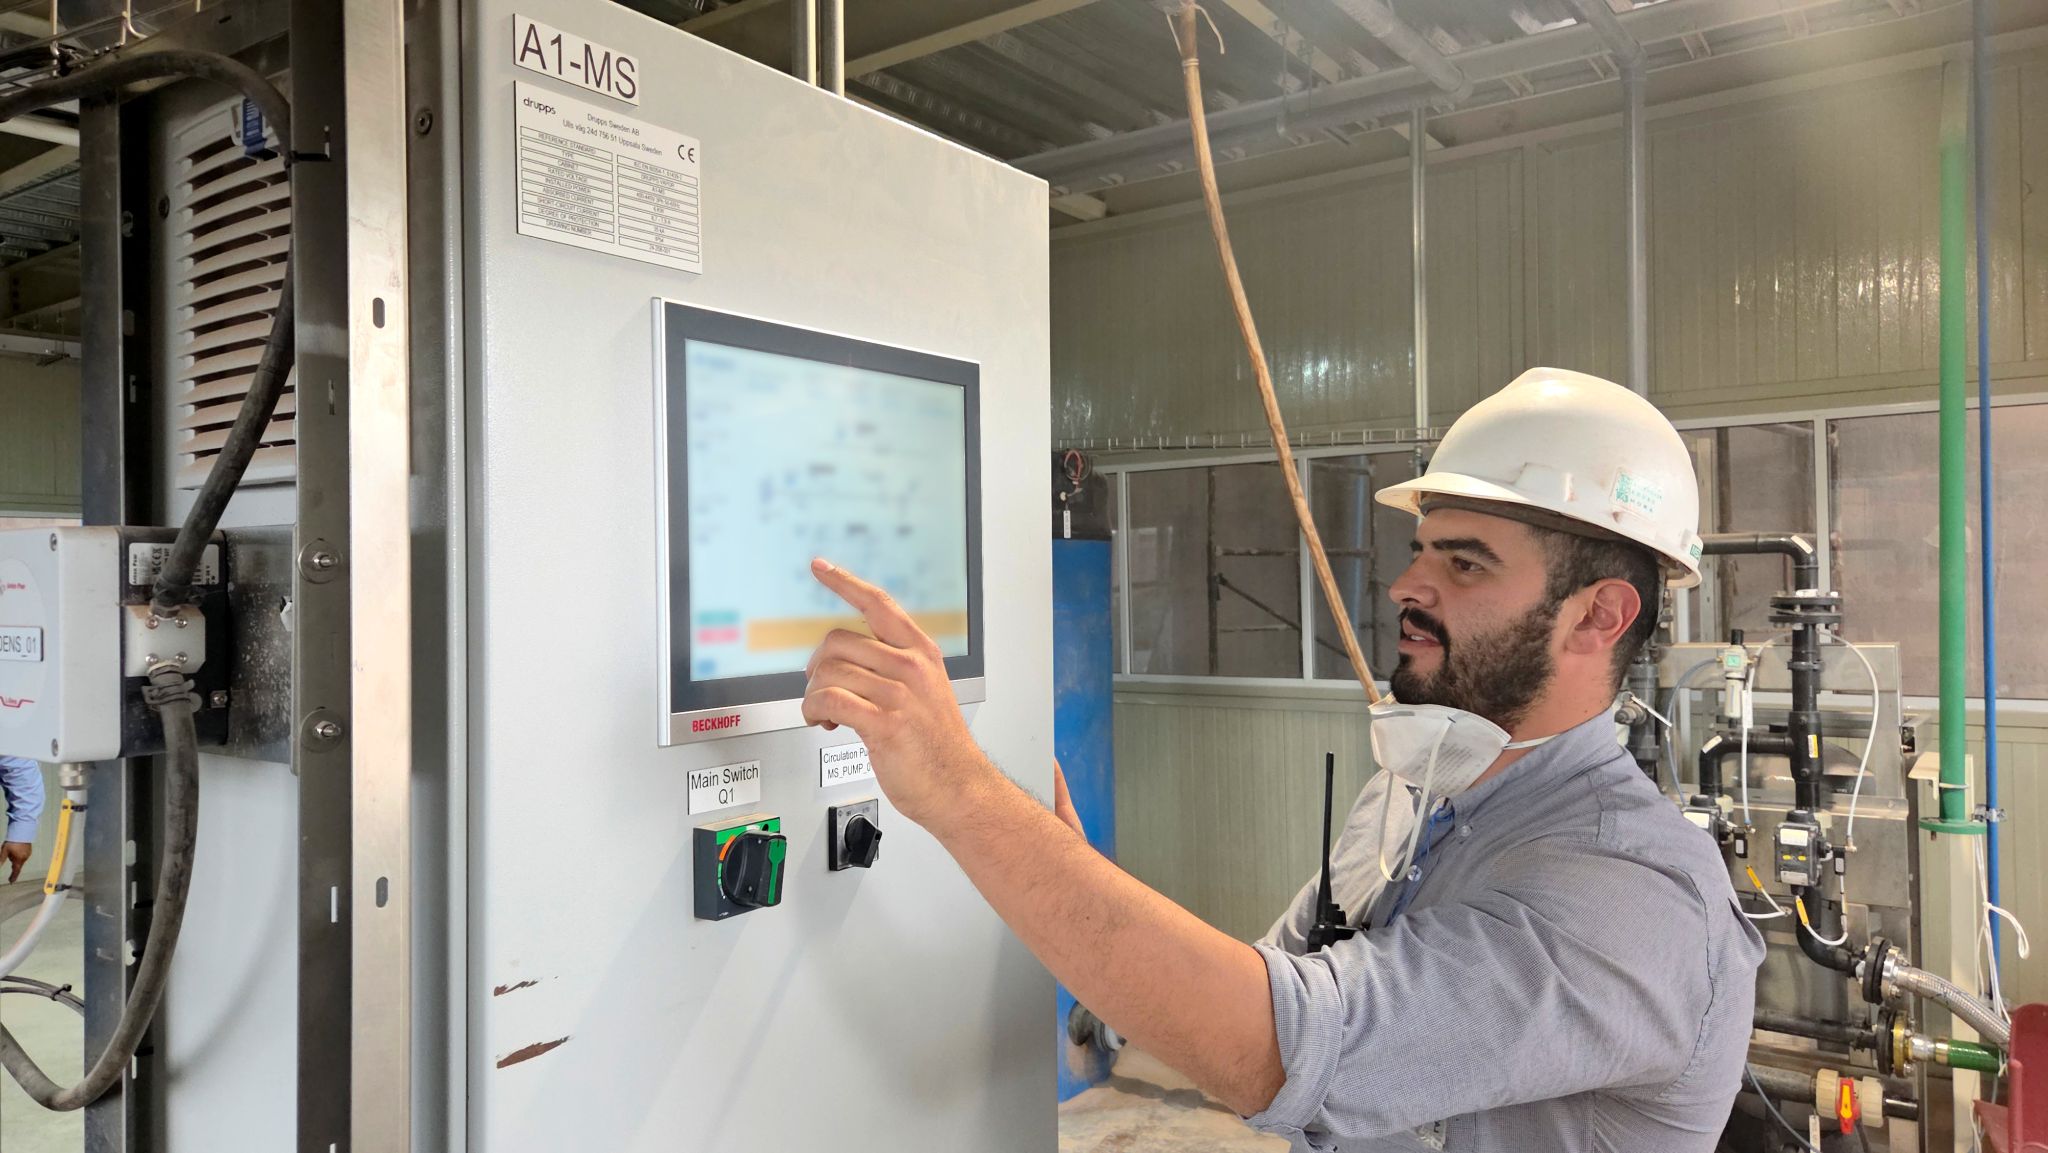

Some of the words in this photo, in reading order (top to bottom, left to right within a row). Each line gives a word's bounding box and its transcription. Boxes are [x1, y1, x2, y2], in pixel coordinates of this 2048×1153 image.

[520, 23, 636, 99] A1-MS
[524, 98, 556, 115] drupps
[587, 113, 608, 126] Drupps
[609, 120, 630, 133] Sweden
[632, 128, 640, 136] AB
[538, 132, 568, 146] REFERENCE
[570, 142, 596, 154] STANDARD
[586, 126, 598, 137] 24d
[642, 144, 662, 156] Sweden
[562, 150, 574, 159] TYPE
[558, 159, 579, 170] CABINET
[548, 168, 564, 177] RATED
[566, 172, 587, 182] VOLTAGE
[545, 177, 572, 188] INSTALLED
[572, 184, 591, 194] POWER
[542, 187, 570, 199] ABSORBED
[571, 194, 594, 205] CURRENT
[538, 207, 559, 218] DEGREE
[569, 213, 600, 227] PROTECTION
[576, 206, 600, 218] CURRENT
[546, 219, 570, 231] DRAWING
[571, 224, 592, 236] NUMBER
[692, 714, 741, 732] BECKHOFF
[824, 750, 858, 764] Circulation
[691, 771, 719, 790] Main
[723, 764, 758, 784] Switch
[828, 762, 870, 779] MS_PUMP_0
[718, 787, 734, 804] Q1
